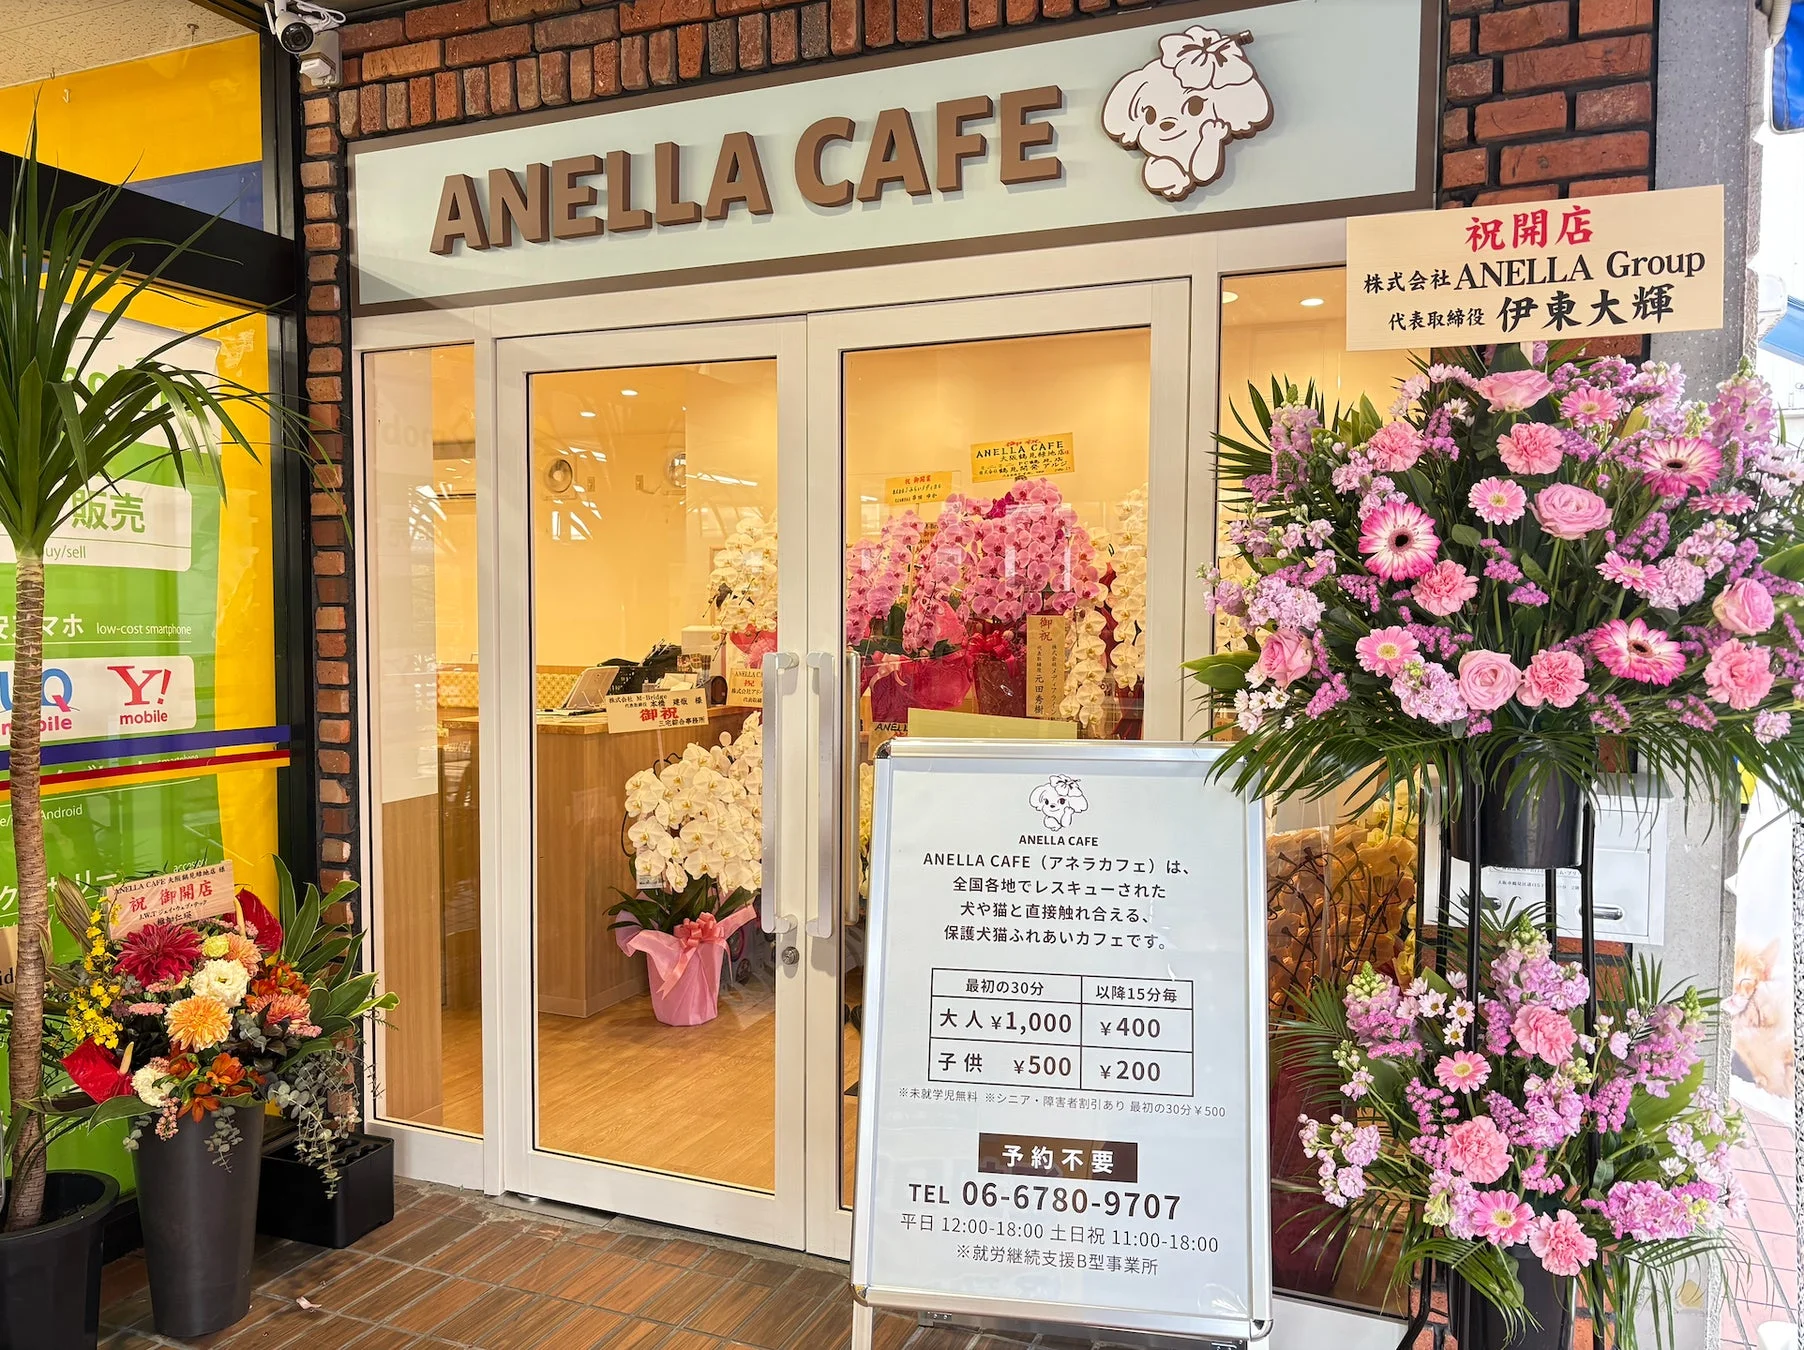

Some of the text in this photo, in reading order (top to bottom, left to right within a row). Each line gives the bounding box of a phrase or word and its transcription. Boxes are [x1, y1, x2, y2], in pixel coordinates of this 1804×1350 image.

[428, 84, 1064, 255] ANELLA CAFE
[1465, 205, 1594, 252] 祝開店
[1606, 250, 1706, 280] Group
[1388, 283, 1675, 334] 代表取締役 伊東大輝
[975, 446, 1026, 458] ANELLA
[1030, 440, 1064, 452] CAFE
[71, 490, 146, 534] 販売
[0, 614, 192, 641] マホ low-cost smartphone
[1039, 617, 1053, 642] 御祝
[107, 665, 172, 707] Y!
[609, 696, 633, 704] 株式会社
[2, 710, 168, 736] mbile mobile
[640, 706, 679, 722] 御祝
[1018, 834, 1100, 847] ANELLA CAFE
[923, 852, 986, 868] ANELLA
[129, 879, 213, 913] 祝 御開店
[145, 878, 167, 890] CAFE
[952, 875, 1167, 900] 全国各地でレスキューされた
[960, 902, 1153, 924] 犬や猫と直接触れ合える、
[943, 924, 1168, 951] 保護犬猫ふれあいカフェです。
[965, 978, 1178, 1003] 最初の30分 以降15分毎
[990, 1011, 1073, 1036] ¥1,000
[1100, 1017, 1161, 1039] ¥400
[1014, 1055, 1073, 1077] ¥500
[1100, 1060, 1161, 1082] ¥200
[898, 1087, 978, 1103] ※未就学児無料
[984, 1092, 1125, 1112] ※シニア・障害者割引あり
[1001, 1144, 1116, 1175] 予約不要
[908, 1180, 1182, 1221] TEL 06-6780-9707
[900, 1212, 1219, 1253] 平日 12:00-18:00 土日祝 11:00-18:00
[956, 1244, 1159, 1277] ※就労継続支援B型事業所
